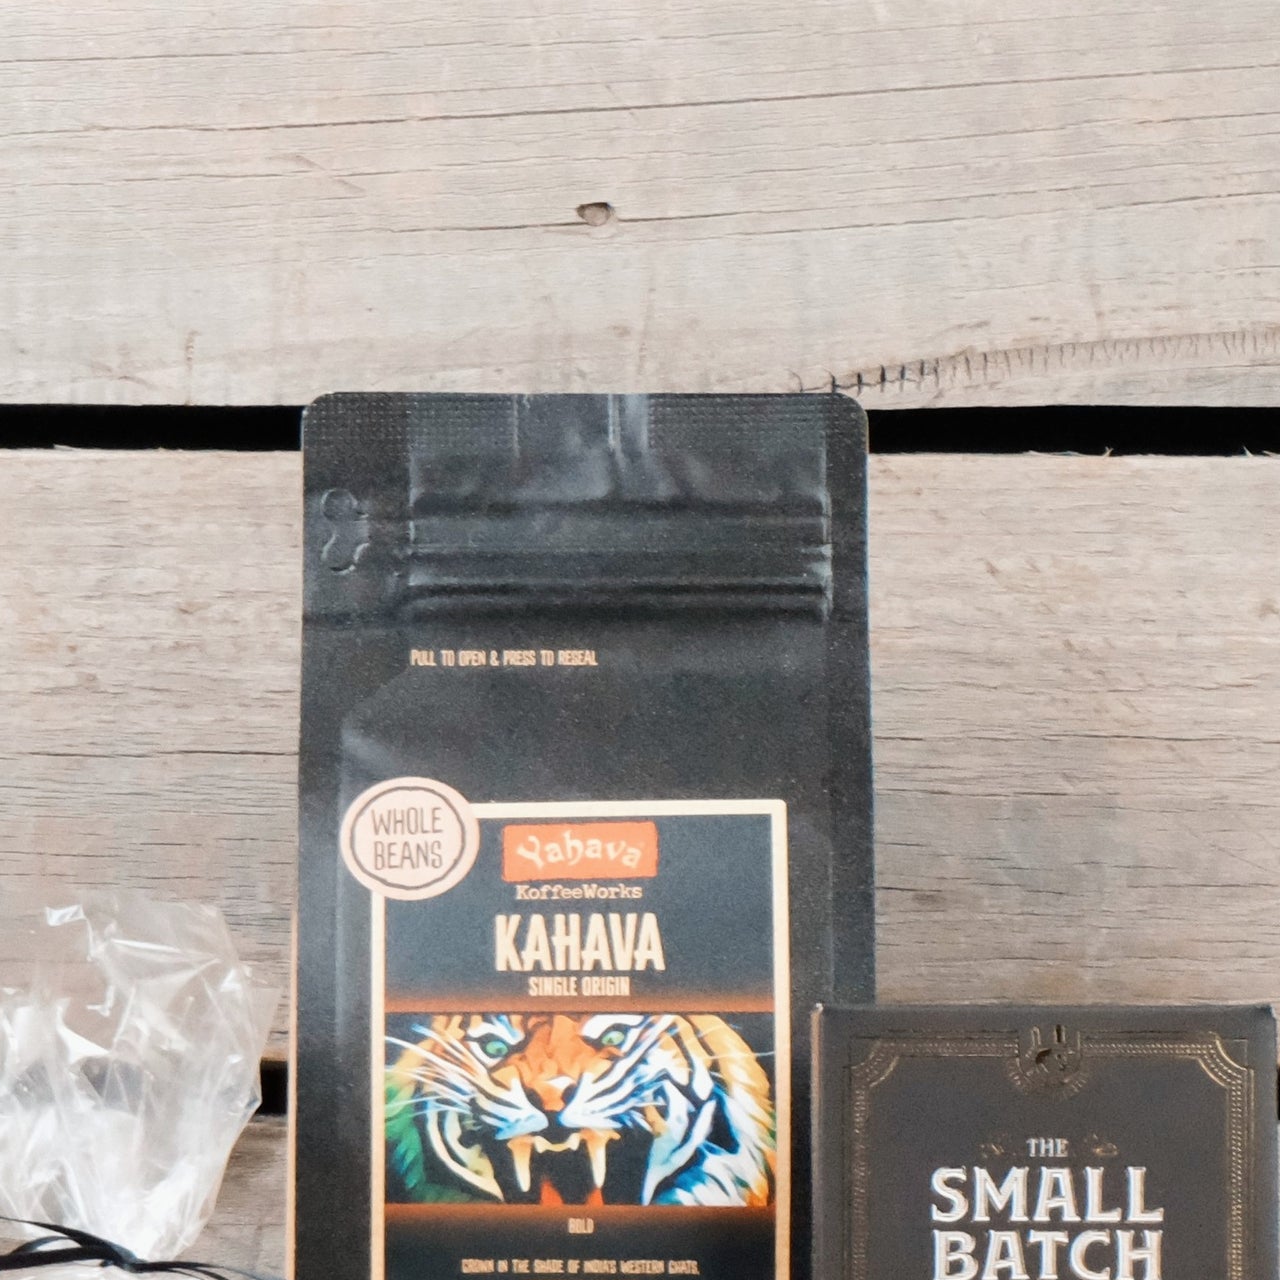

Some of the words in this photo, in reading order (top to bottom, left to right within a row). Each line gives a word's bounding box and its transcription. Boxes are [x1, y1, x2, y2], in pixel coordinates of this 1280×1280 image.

[410, 649, 437, 666] PULL
[440, 649, 455, 666] TO
[458, 649, 486, 667] OPEN
[490, 650, 500, 667] &
[503, 649, 537, 667] PRESS
[540, 650, 555, 666] TO
[558, 650, 598, 666] RESEAL
[371, 807, 443, 836] WHOLE
[373, 840, 443, 870] BEANS
[516, 830, 643, 869] Yahava
[516, 883, 643, 900] KoffeeWorks
[495, 912, 666, 971] KAHAVA
[529, 976, 577, 997] SINGLE
[582, 976, 630, 996] ORIGIN
[1026, 1138, 1069, 1158] THE
[930, 1165, 1164, 1223] SMALL
[512, 1259, 530, 1274] THE
[567, 1259, 580, 1274] OF
